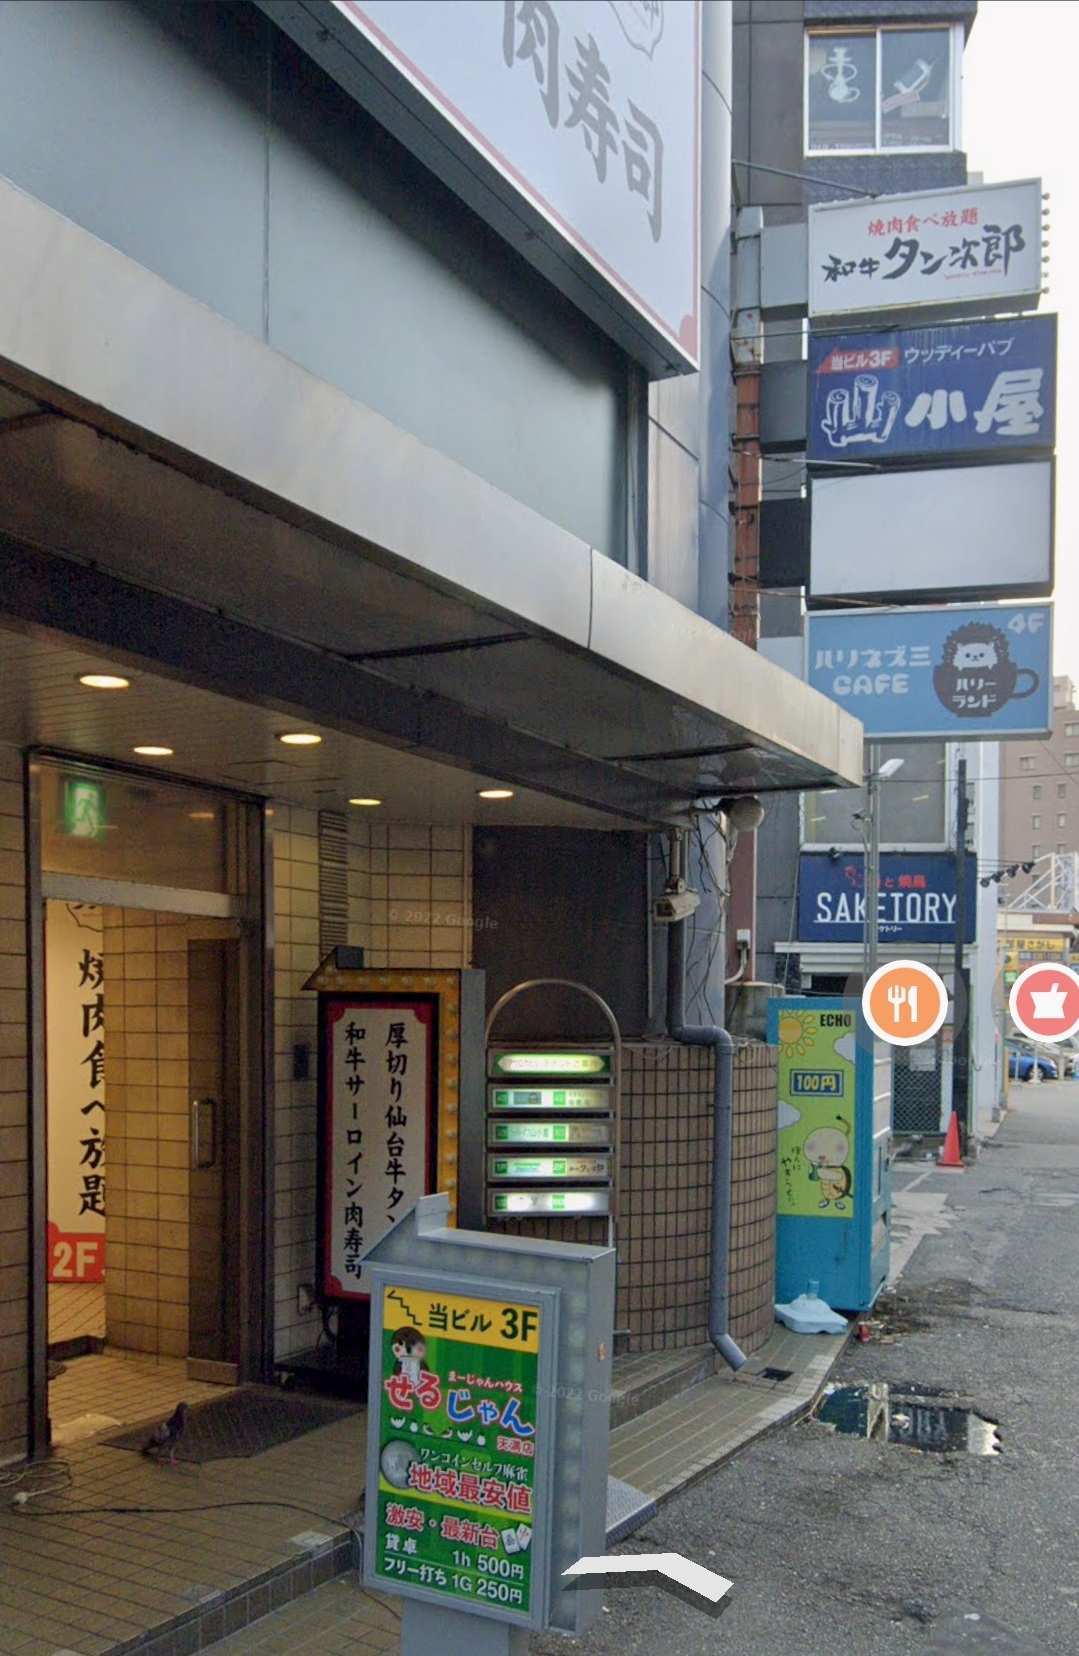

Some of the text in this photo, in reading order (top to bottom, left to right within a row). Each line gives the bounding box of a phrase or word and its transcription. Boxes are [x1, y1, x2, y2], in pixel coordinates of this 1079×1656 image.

[867, 207, 979, 237] 焼肉食べ放題
[821, 223, 1026, 283] 和牛タン次郎
[1006, 613, 1045, 634] 4F
[815, 646, 931, 669] ハリネズミ
[833, 674, 910, 695] CAFE
[956, 677, 997, 692] ハリー
[952, 695, 997, 709] ランド
[817, 892, 957, 922] SAKETORY
[820, 1014, 852, 1028] ECHO
[53, 1241, 98, 1278] 2F
[428, 1302, 538, 1341] 当ビル 3F
[408, 1462, 533, 1514] 地域最安値
[383, 1556, 524, 1605] フリー打ち 1G 250円
[452, 1550, 472, 1568] 1h
[477, 1554, 525, 1581] 500円
